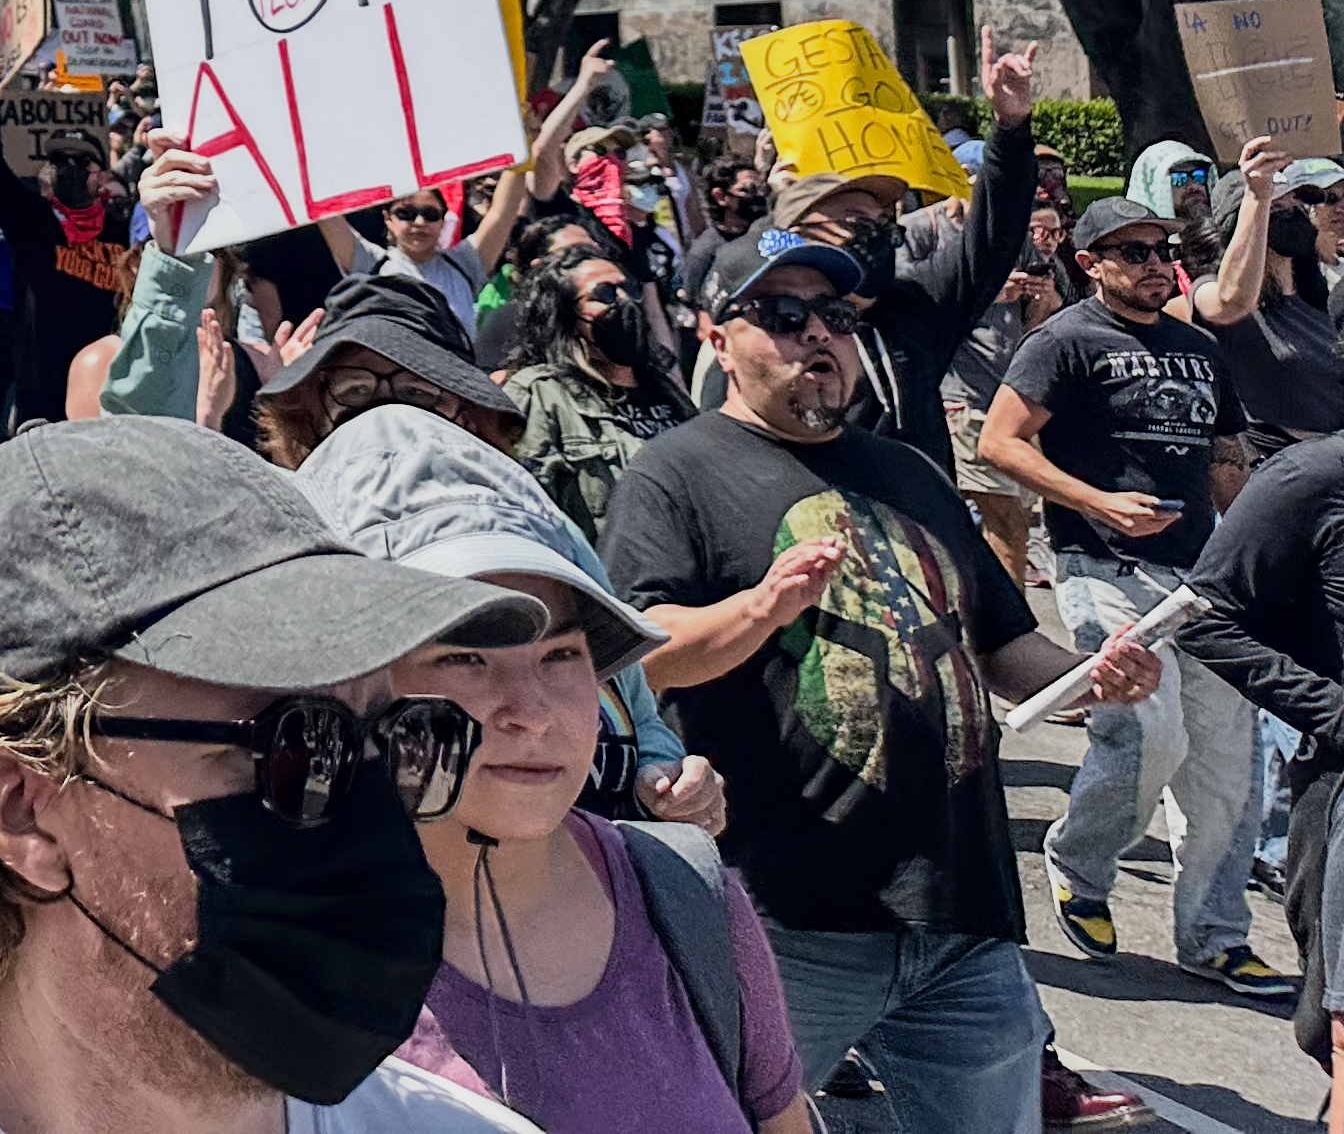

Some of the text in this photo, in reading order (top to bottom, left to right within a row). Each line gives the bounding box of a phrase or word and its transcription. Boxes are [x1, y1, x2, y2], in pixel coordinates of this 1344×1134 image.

[1183, 9, 1262, 35] LA NO
[61, 29, 89, 44] OUT
[765, 26, 888, 79] GESTA
[1, 98, 104, 126] ABOLISH
[170, 2, 515, 254] ALL
[1219, 119, 1249, 139] GET
[1108, 355, 1214, 382] MARTYRS
